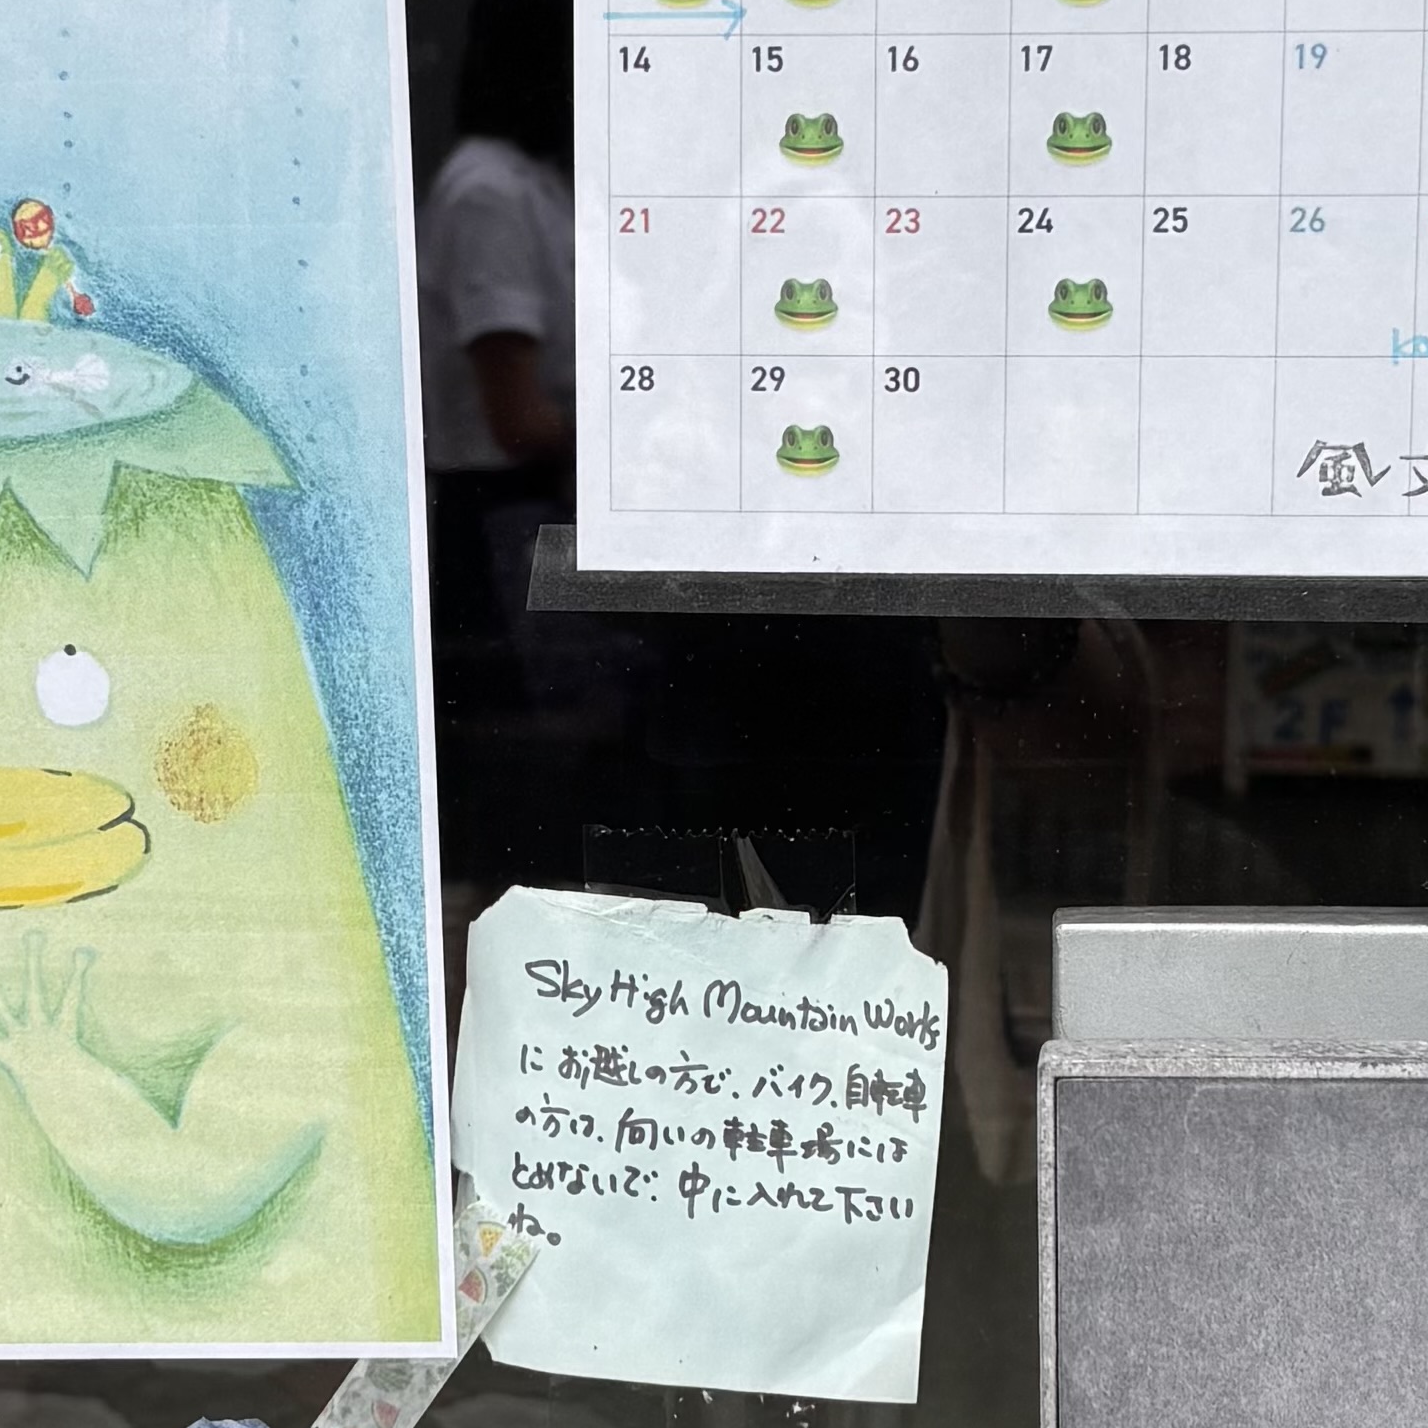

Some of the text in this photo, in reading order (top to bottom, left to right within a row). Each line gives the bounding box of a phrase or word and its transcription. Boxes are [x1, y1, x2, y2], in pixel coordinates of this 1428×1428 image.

[618, 45, 652, 73] 14
[751, 45, 784, 73] 15
[887, 44, 920, 73] 16
[1020, 44, 1054, 73] 17
[1159, 43, 1192, 71] 18
[1295, 42, 1328, 70] 19
[619, 207, 650, 234] 21
[750, 207, 786, 234] 22
[885, 207, 921, 234] 23
[1017, 206, 1054, 234] 24
[1152, 206, 1189, 234] 25
[1289, 206, 1326, 233] 26
[619, 365, 921, 393] 28 29 30
[524, 959, 941, 1052] Sky High Mountain Works
